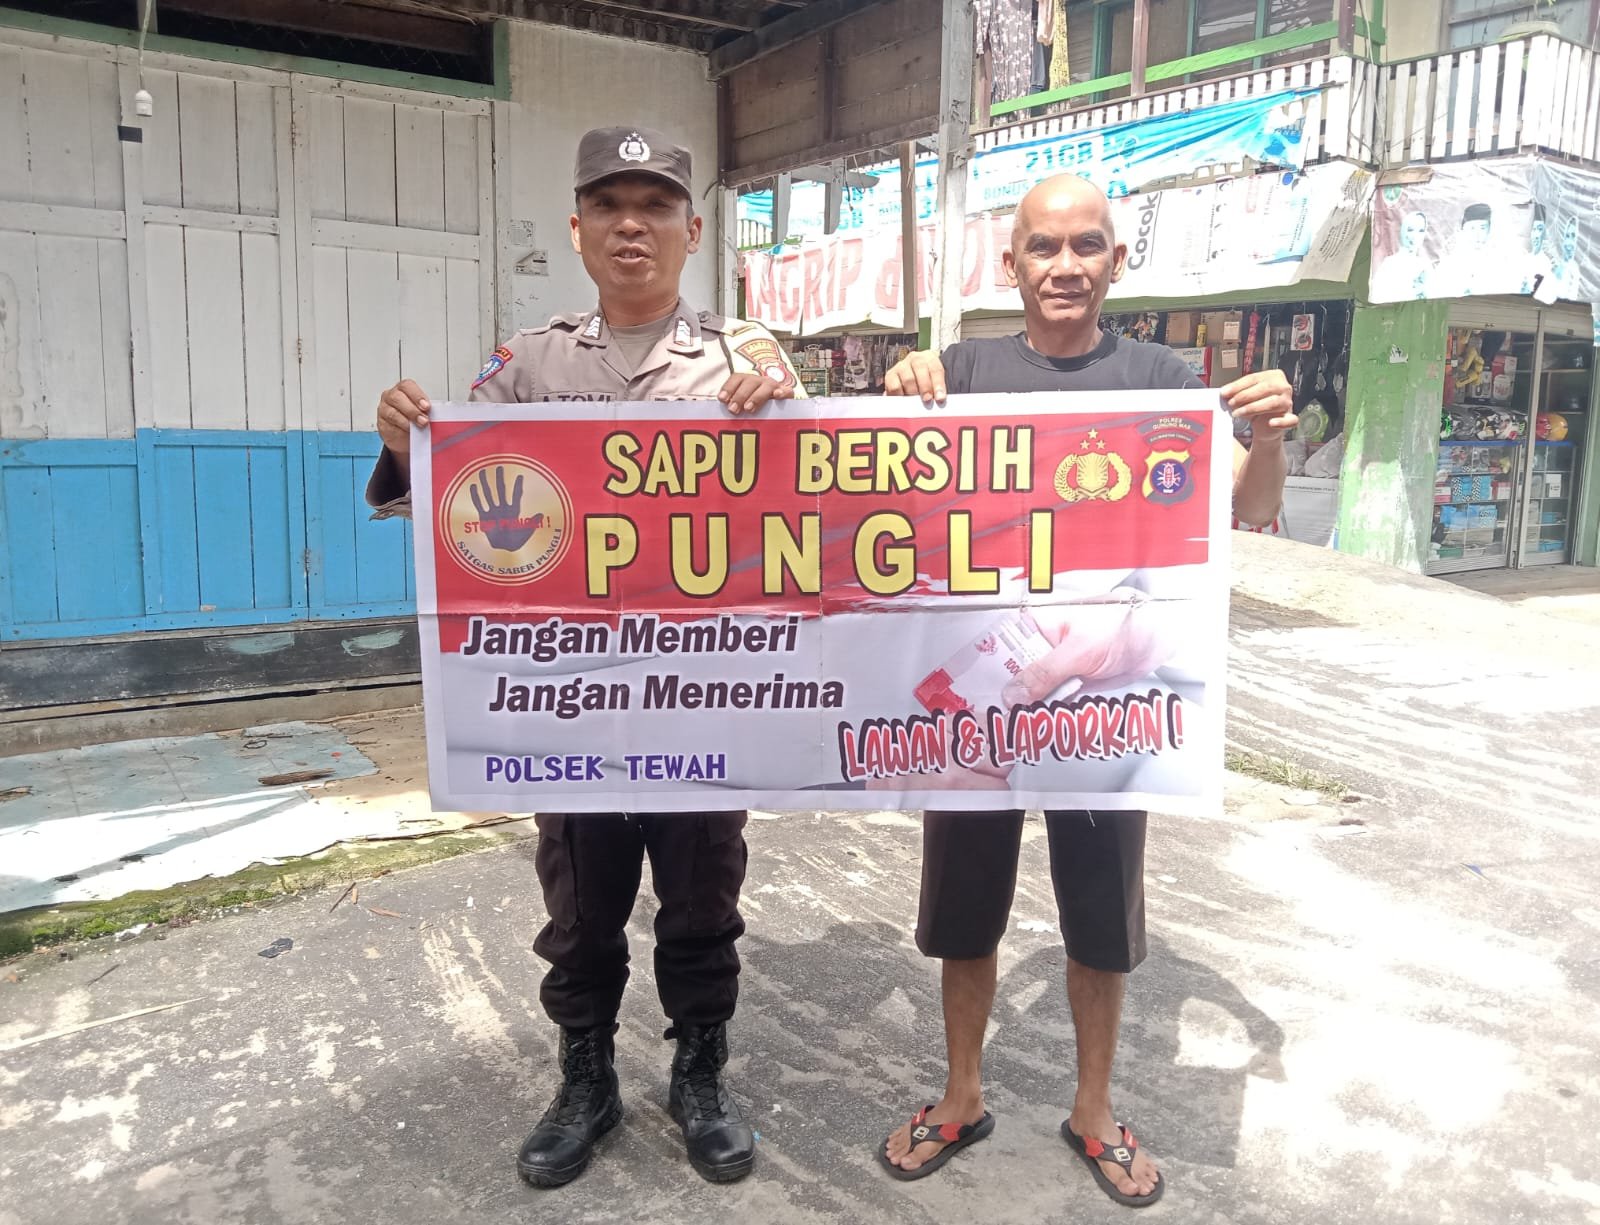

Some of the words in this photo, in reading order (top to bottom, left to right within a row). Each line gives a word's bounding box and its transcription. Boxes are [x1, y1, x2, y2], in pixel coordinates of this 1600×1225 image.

[1127, 192, 1159, 271] Cocok
[602, 430, 760, 497] SAPU
[794, 424, 1035, 497] BERSIH
[456, 540, 495, 573] SATGAS
[498, 563, 535, 575] SABER
[536, 528, 562, 566] PUNGLI
[584, 508, 1055, 599] PUNGLI
[463, 619, 609, 663] Jangan
[619, 616, 799, 654] Memberi
[488, 675, 631, 719] Jangan
[642, 673, 845, 710] Menerima
[839, 708, 949, 782] LAWAN
[953, 709, 986, 768] &
[988, 689, 1164, 768] LAPORKAN
[485, 755, 604, 783] POLSEK
[624, 753, 727, 780] TEWAH
